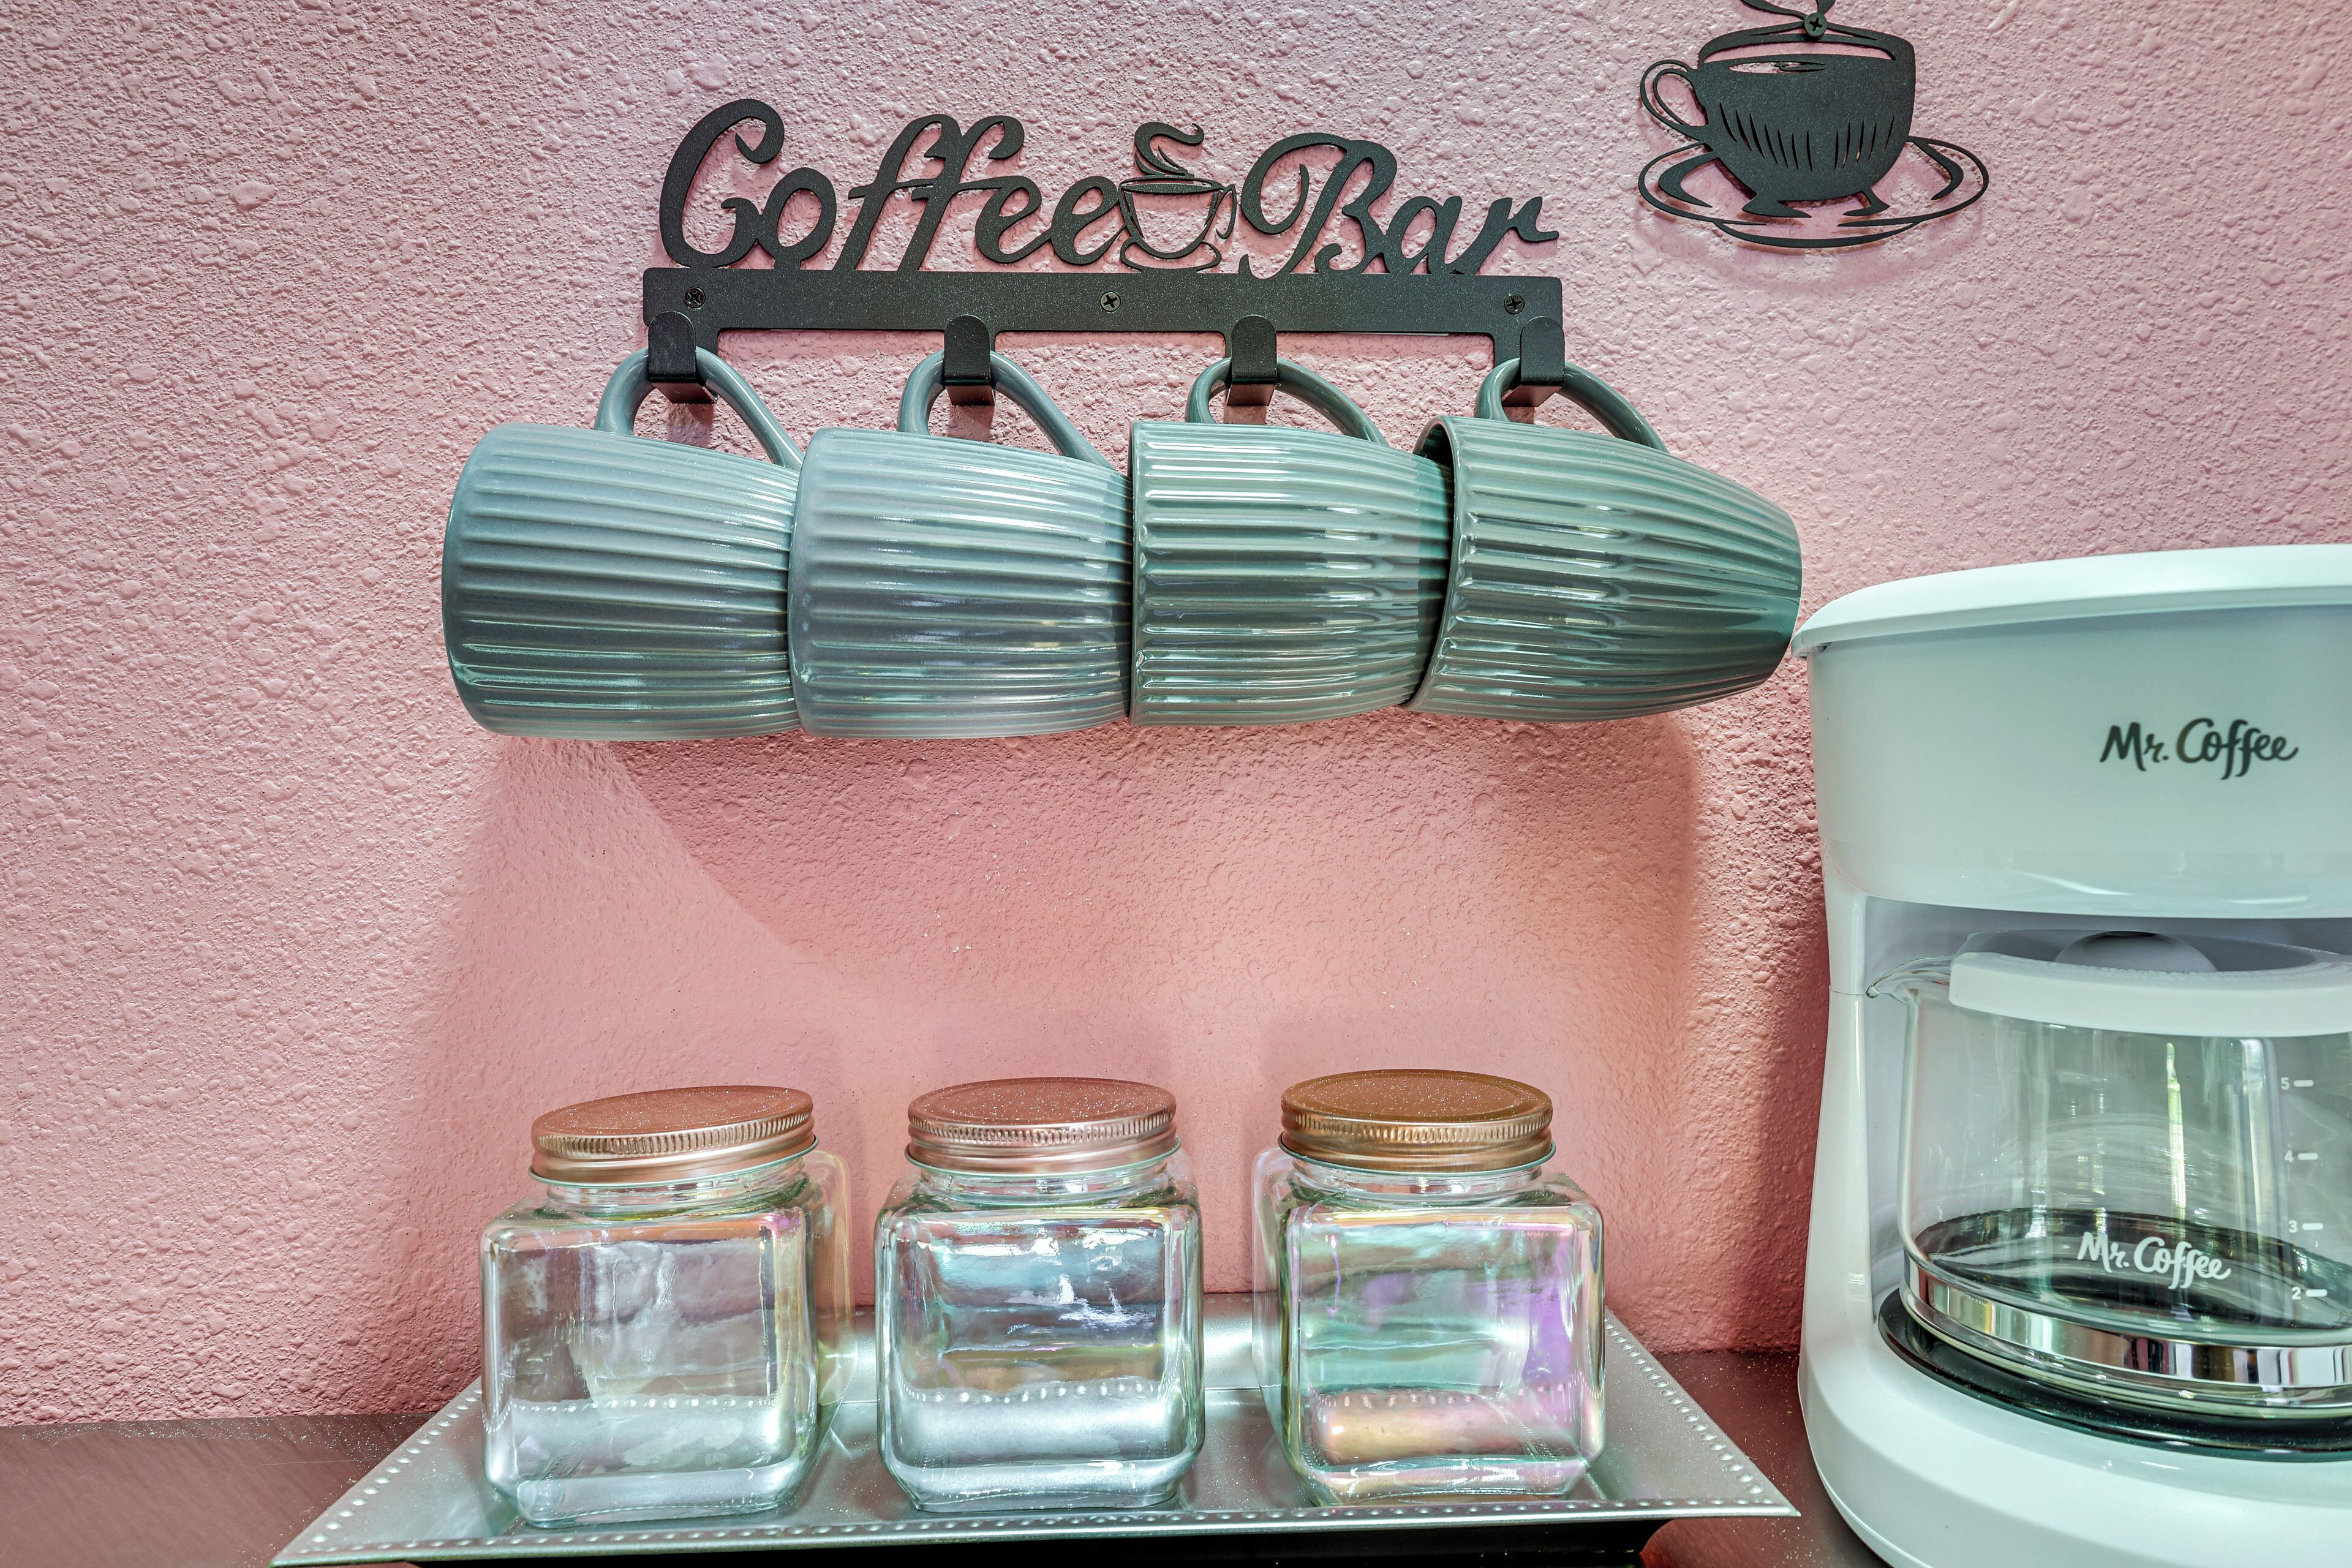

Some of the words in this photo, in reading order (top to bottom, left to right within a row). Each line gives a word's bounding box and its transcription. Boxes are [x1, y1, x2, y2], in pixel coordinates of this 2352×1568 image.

[659, 99, 1122, 271] Coffee
[1238, 133, 1560, 279] Bar
[2100, 722, 2169, 772] Mr.
[2176, 717, 2299, 780] Coffee
[2280, 1077, 2290, 1090] 5
[2283, 1150, 2294, 1163] 4
[2288, 1219, 2299, 1234] 3
[2077, 1231, 2130, 1273] Mr.
[2133, 1236, 2231, 1290] Coffee
[2291, 1286, 2302, 1300] 2
